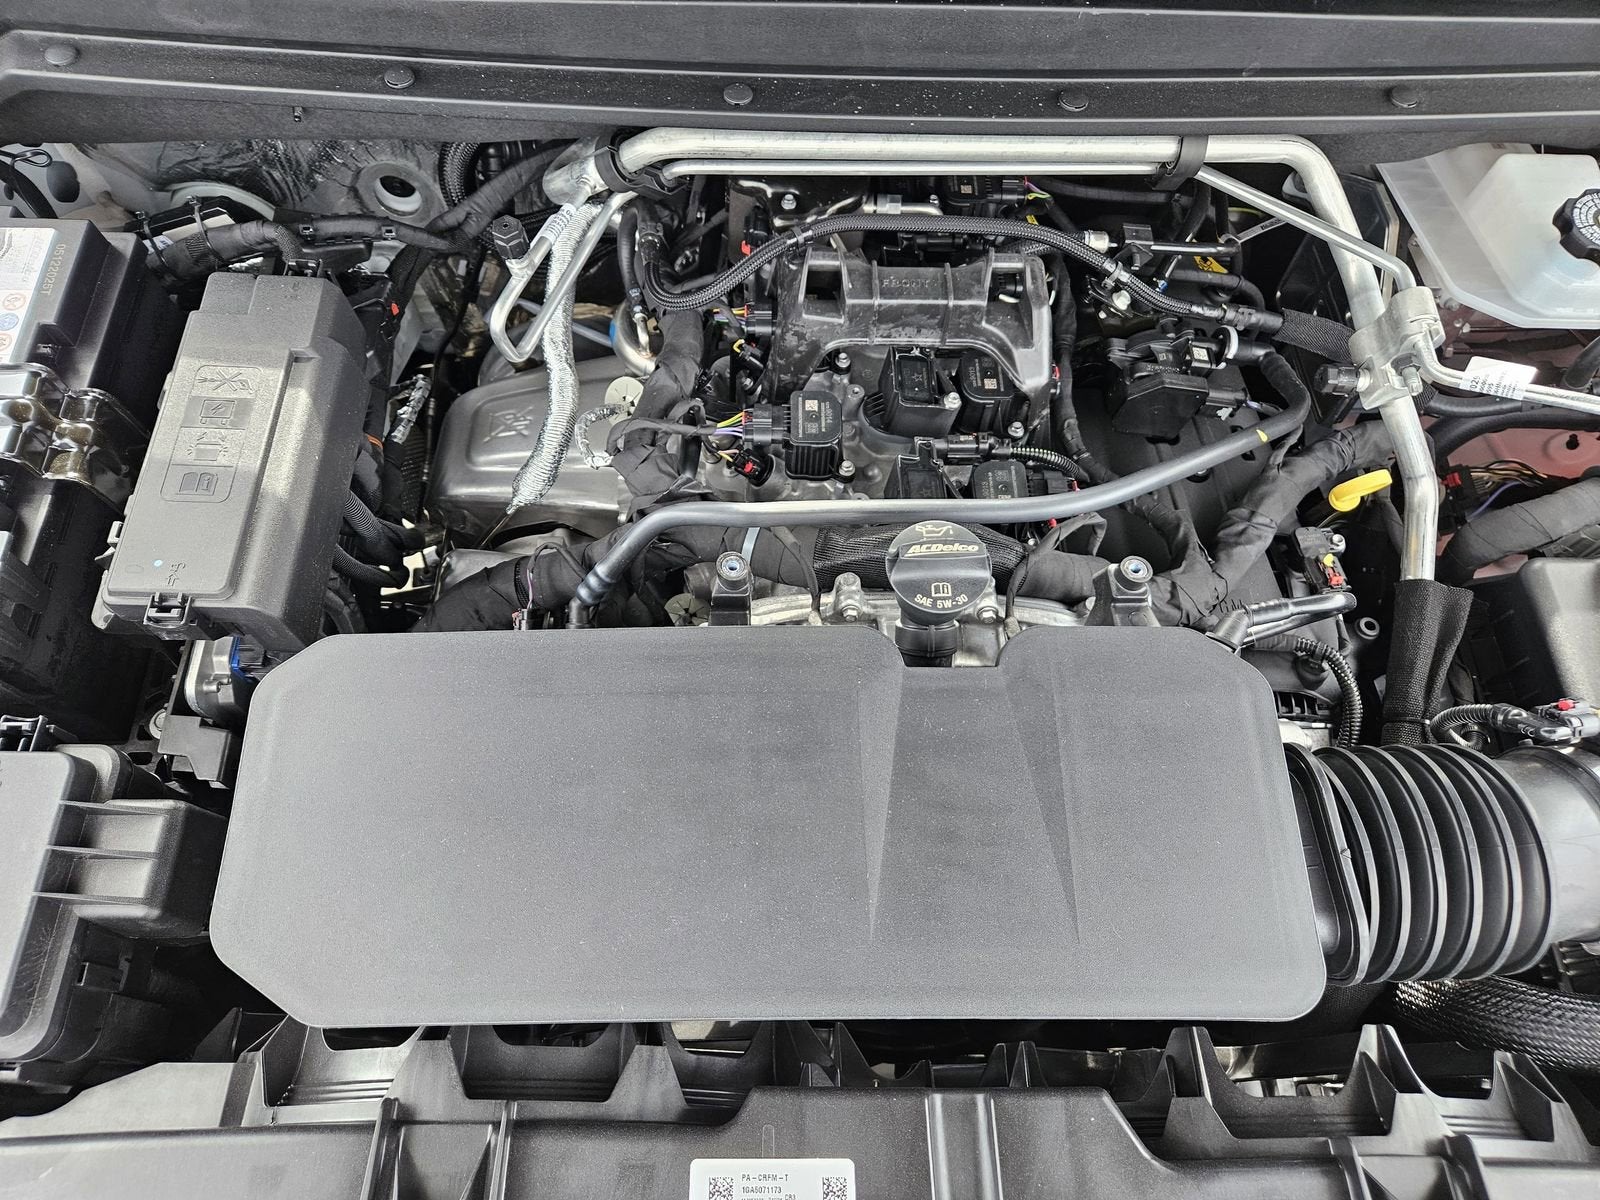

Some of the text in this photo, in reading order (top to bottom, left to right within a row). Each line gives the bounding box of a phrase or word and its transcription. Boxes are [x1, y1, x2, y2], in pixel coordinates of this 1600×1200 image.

[906, 542, 979, 554] ACDelco
[914, 593, 969, 609] SAE 5W-30
